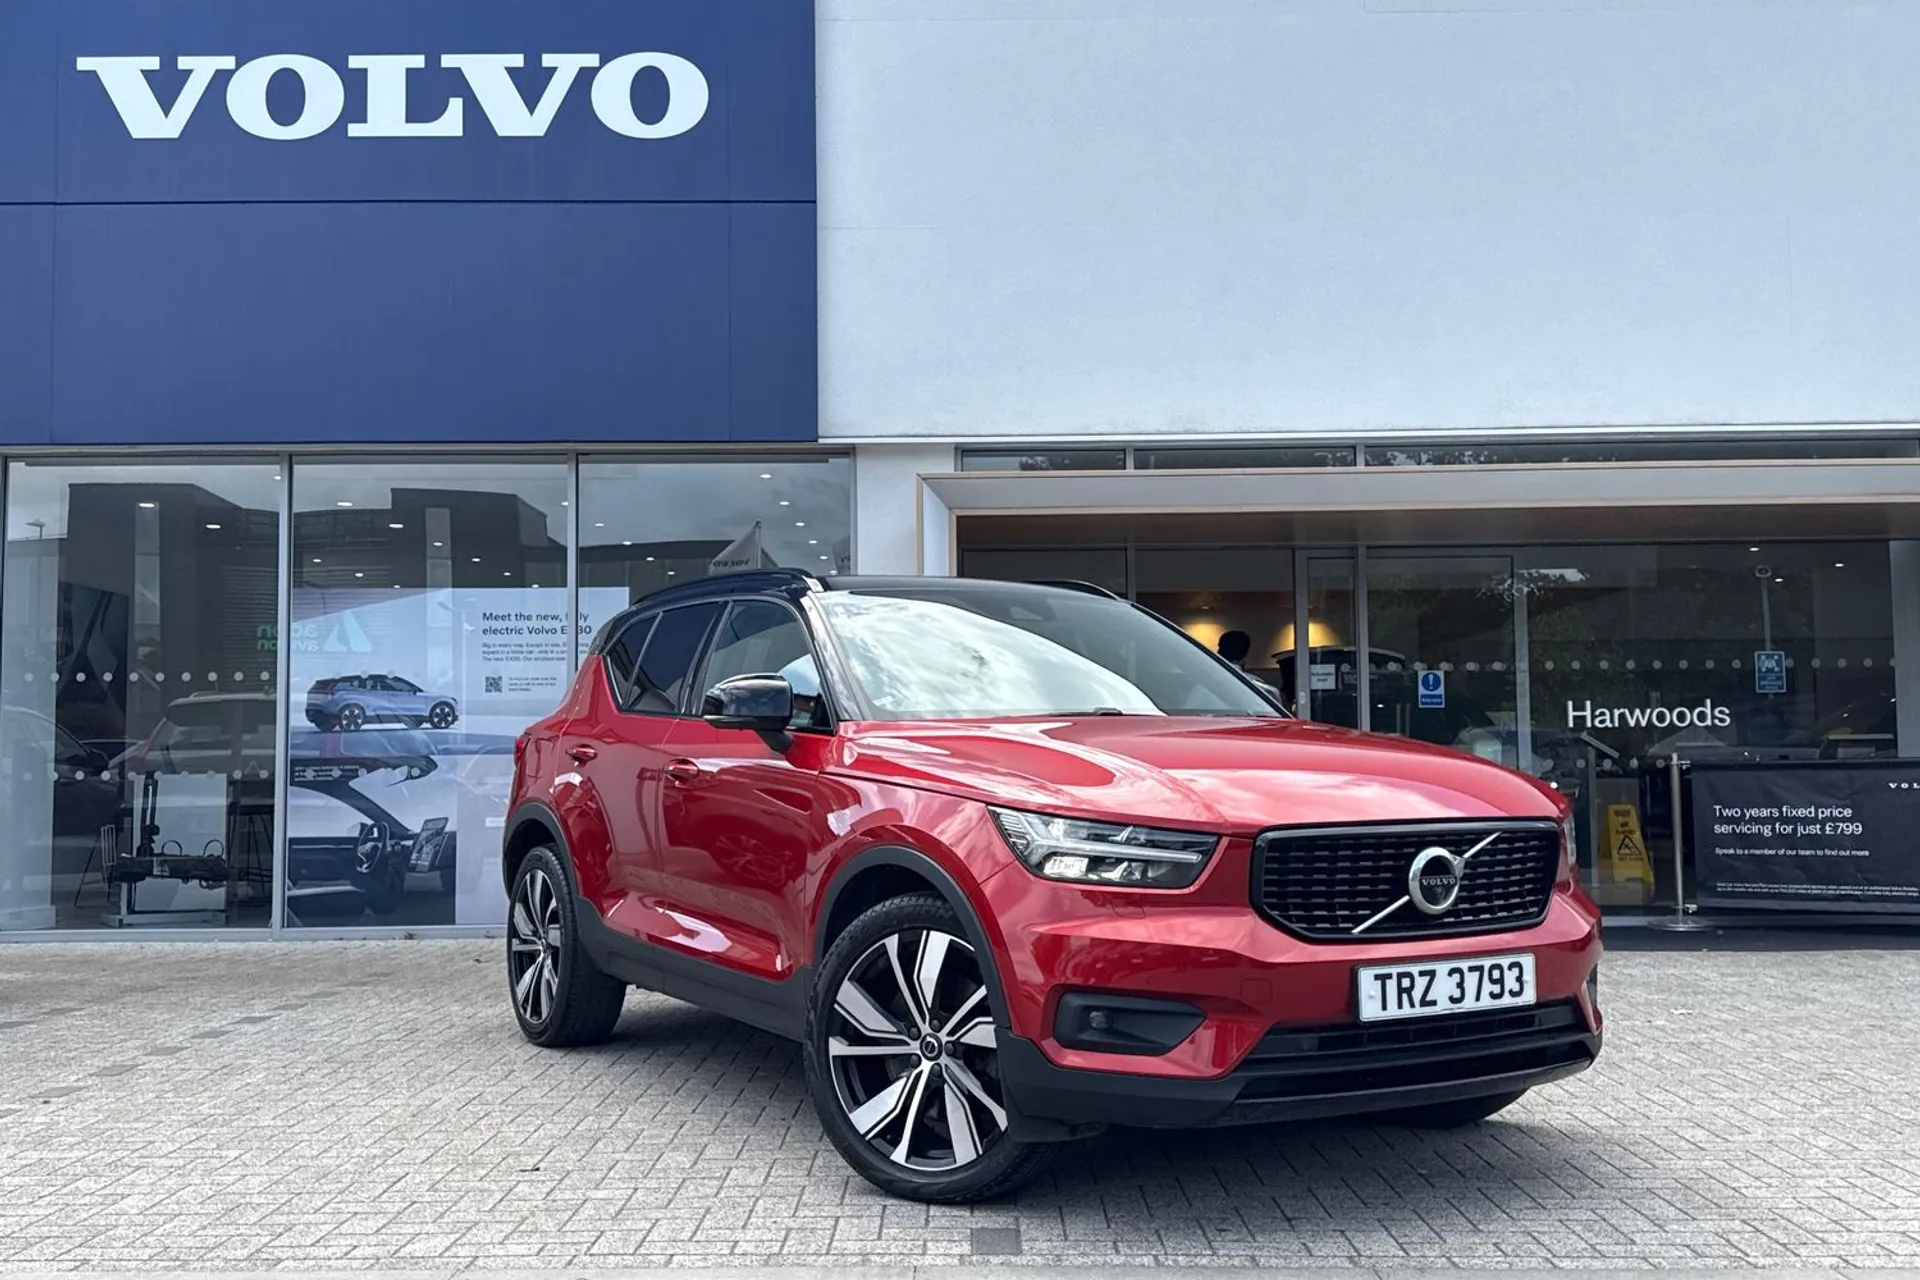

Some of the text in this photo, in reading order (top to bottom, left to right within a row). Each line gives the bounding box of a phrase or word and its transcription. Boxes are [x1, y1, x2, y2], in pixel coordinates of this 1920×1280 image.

[76, 52, 709, 140] VOLVO
[482, 612, 511, 621] Meet
[514, 612, 533, 621] the
[536, 613, 562, 623] new,
[482, 625, 592, 635] electric Volvo E30
[1566, 698, 1731, 729] Harwoods
[1713, 805, 1853, 820] Two years fixed price
[1713, 822, 1863, 837] servicing for just £799
[1715, 847, 1736, 856] Speak
[1422, 878, 1456, 886] VOLVO
[1373, 961, 1525, 1012] TRZ 3793
